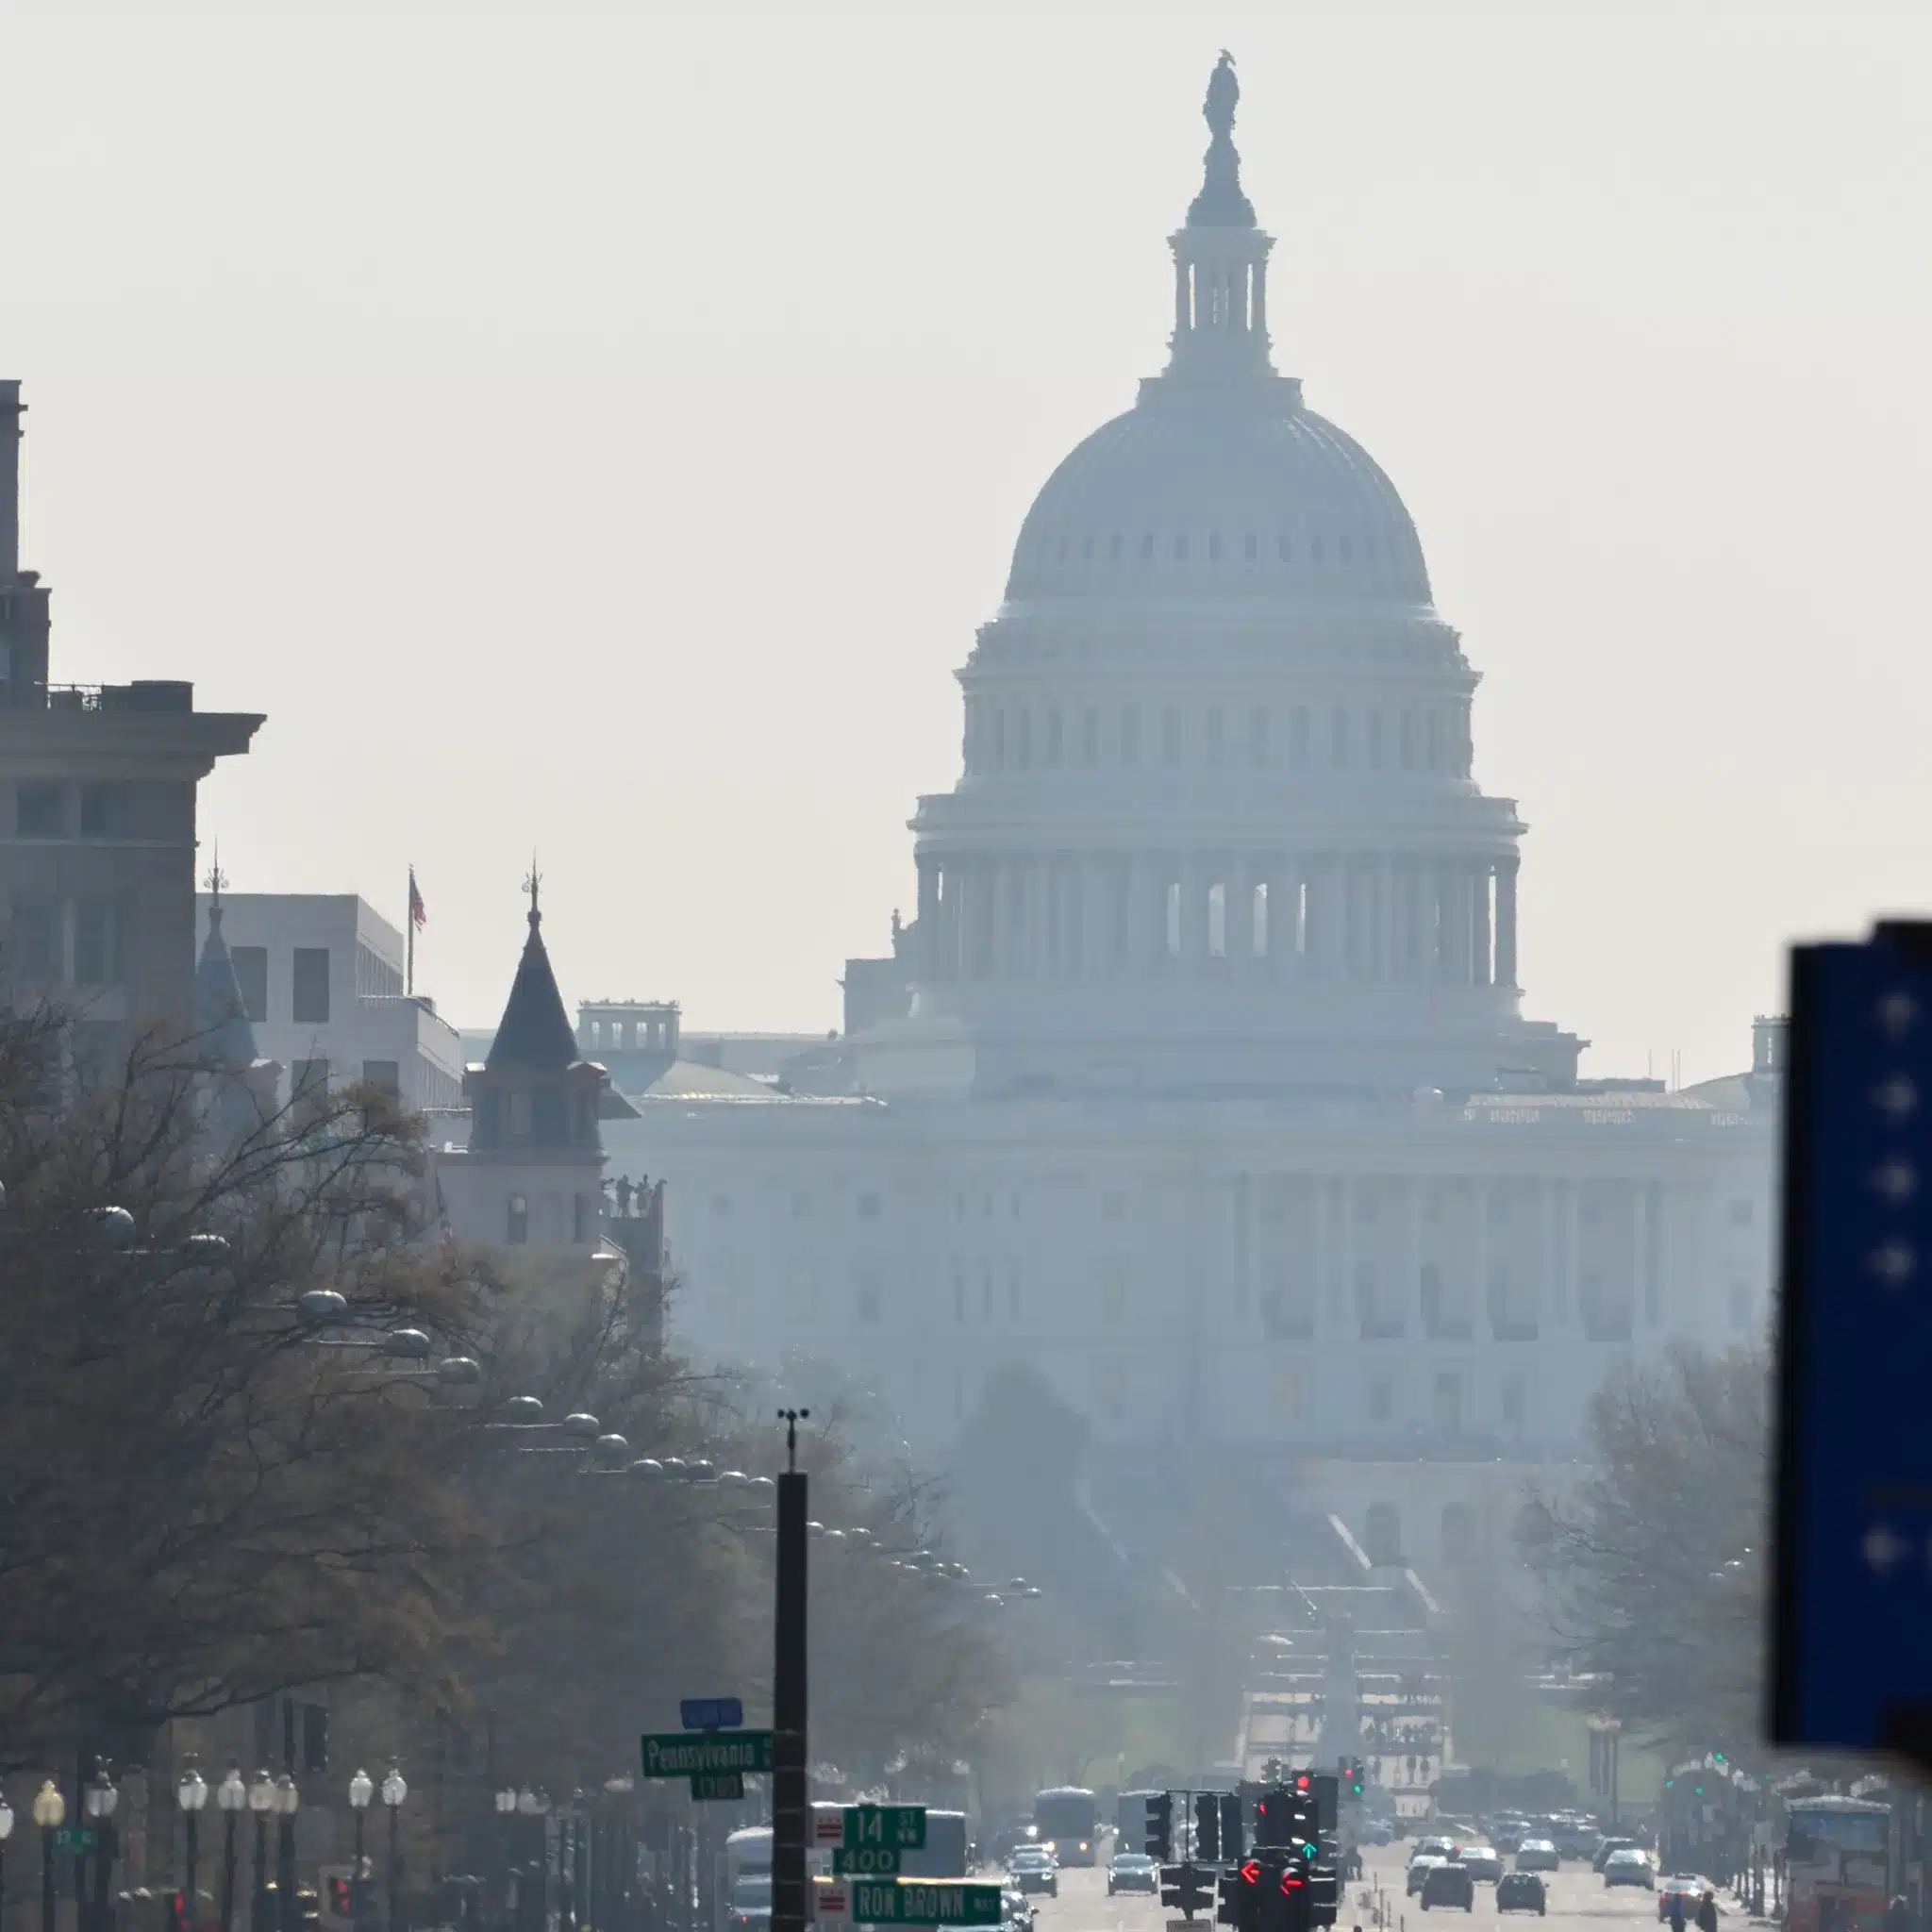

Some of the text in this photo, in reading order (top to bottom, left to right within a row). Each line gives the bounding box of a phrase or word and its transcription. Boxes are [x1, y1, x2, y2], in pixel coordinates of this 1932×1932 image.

[647, 1739, 756, 1772] Pennsylvania
[857, 1810, 882, 1842] 14
[840, 1849, 893, 1871] 400
[859, 1886, 894, 1917] RON
[903, 1886, 965, 1918] BROWN
